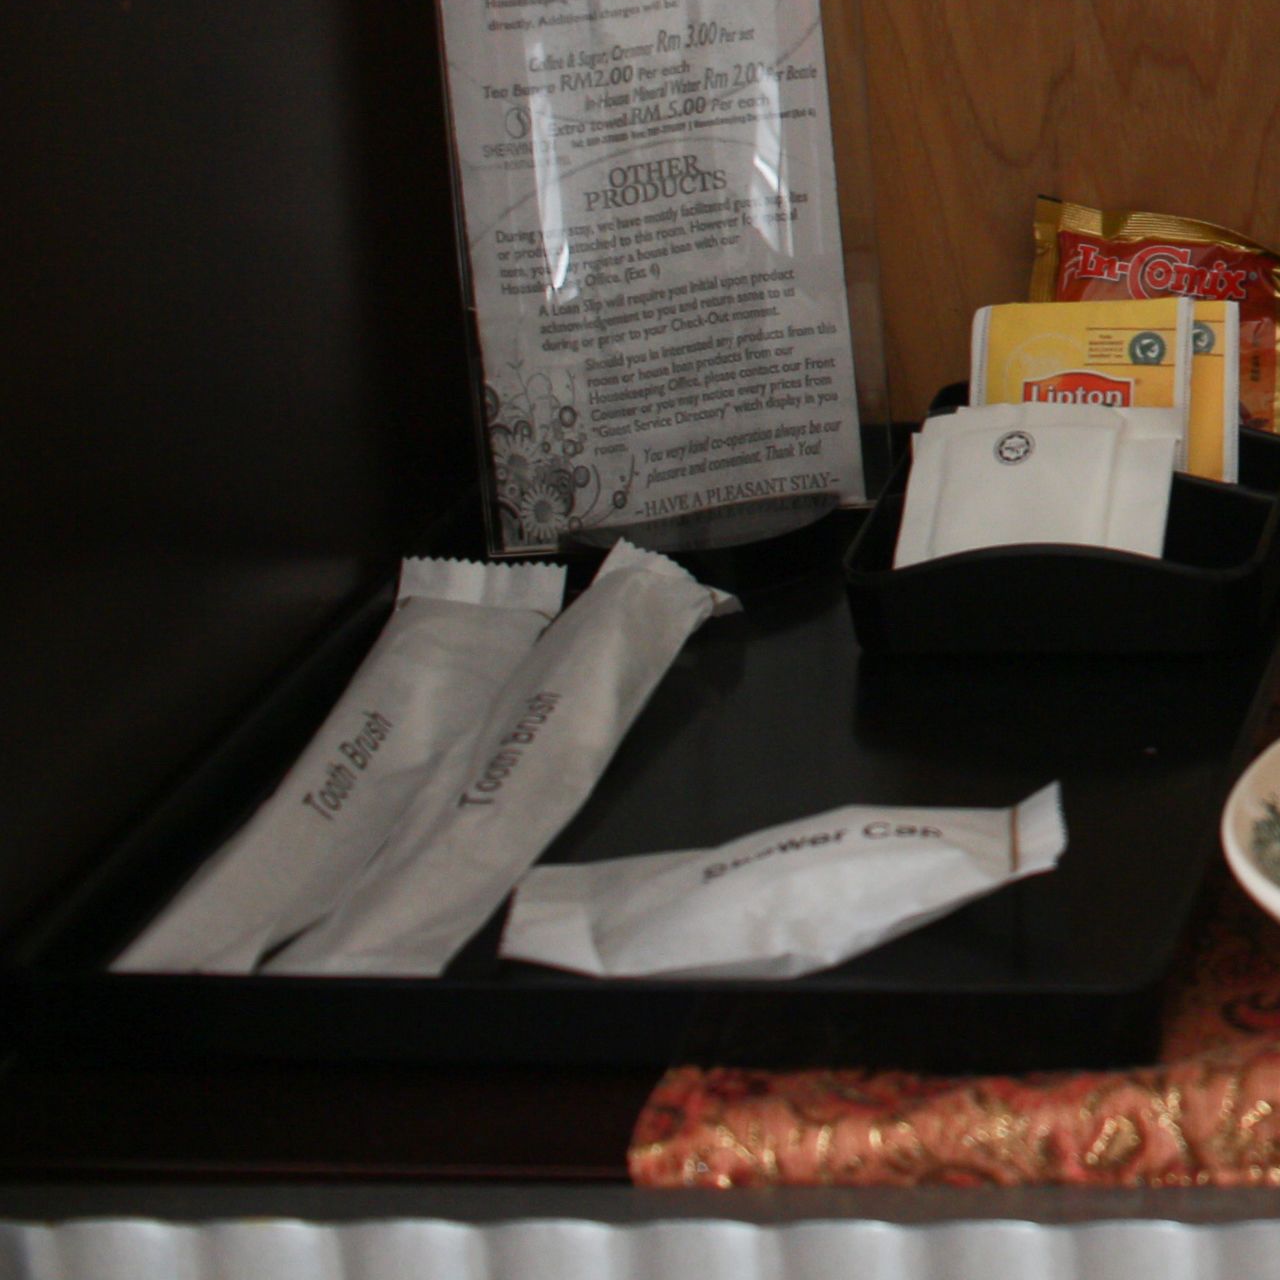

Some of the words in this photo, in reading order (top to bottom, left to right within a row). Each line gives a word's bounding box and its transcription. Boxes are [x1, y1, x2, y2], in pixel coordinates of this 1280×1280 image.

[656, 28, 682, 53] Rm
[684, 21, 719, 50] 3.00
[661, 59, 692, 77] each
[608, 154, 703, 189] OTHER
[583, 168, 728, 213] PRODUCTS
[749, 268, 796, 287] product
[641, 309, 656, 320] to
[766, 288, 781, 299] to
[581, 337, 597, 348] or
[627, 329, 642, 341] to
[643, 324, 669, 341] your
[625, 353, 648, 369] you
[736, 326, 785, 349] products
[786, 323, 816, 338] from
[621, 371, 636, 384] or
[744, 347, 773, 362] from
[774, 345, 795, 358] our
[738, 363, 781, 379] contact
[781, 361, 803, 373] our
[803, 356, 837, 371] Front
[654, 397, 677, 416] you
[701, 387, 736, 402] notice
[633, 416, 673, 433] Service
[643, 445, 665, 465] You
[691, 490, 706, 507] A
[706, 475, 790, 505] PLEASANT
[301, 759, 358, 822] Tooth
[338, 708, 396, 772] Brush
[456, 745, 525, 809] Tooth
[500, 690, 562, 747] Brush
